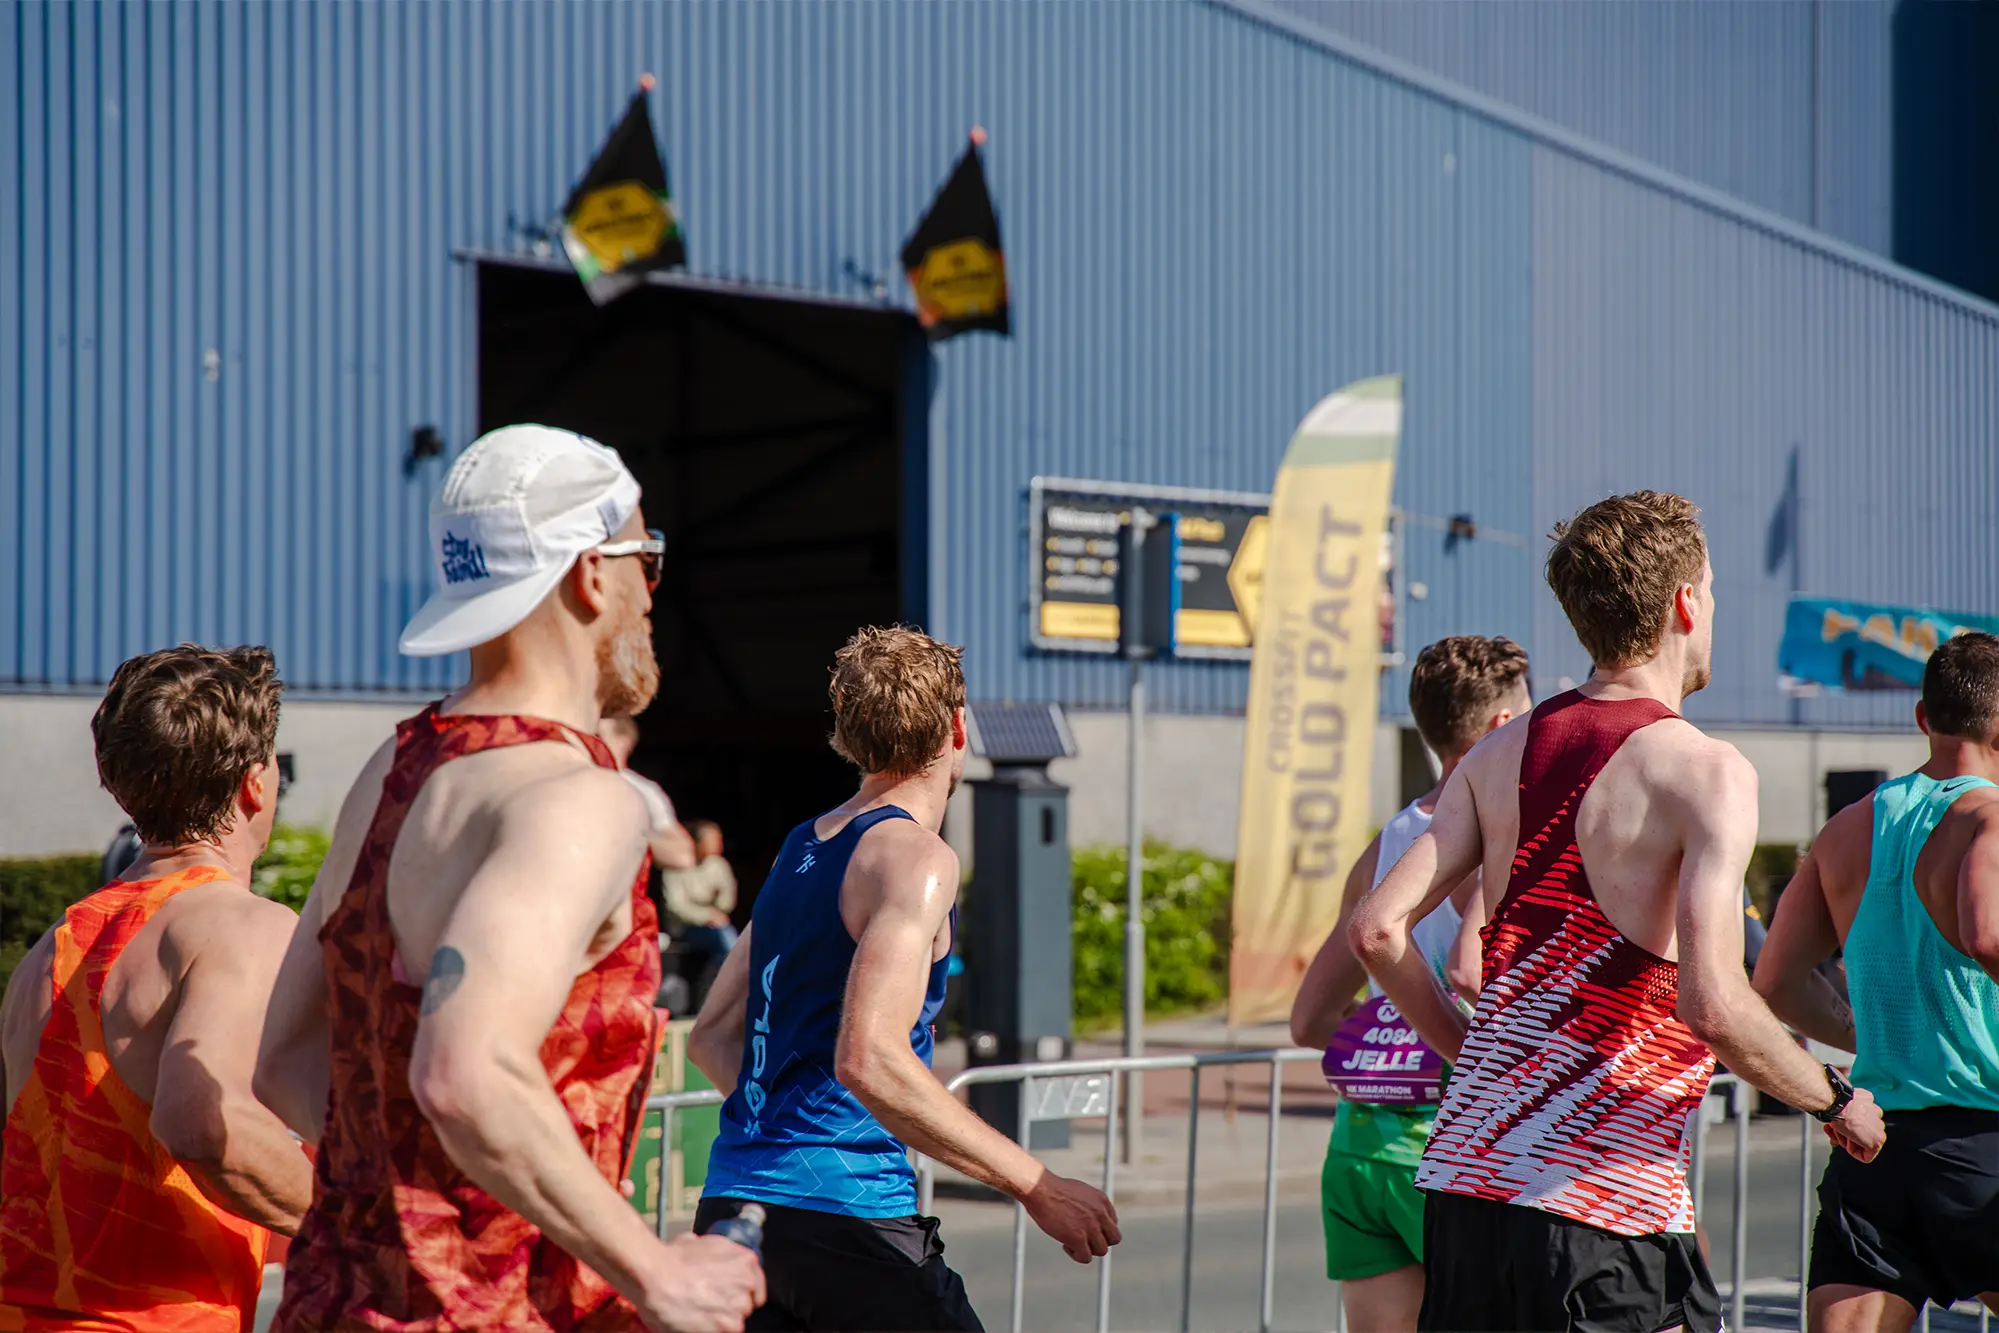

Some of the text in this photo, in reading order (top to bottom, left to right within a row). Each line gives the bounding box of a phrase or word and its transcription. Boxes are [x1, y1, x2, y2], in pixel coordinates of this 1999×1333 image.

[1267, 607, 1304, 775] CROSSFIT
[1289, 504, 1363, 882] GOLD PACT
[1362, 1027, 1418, 1046] 4084
[1341, 1050, 1425, 1071] JELLE
[1357, 1085, 1412, 1095] MARATHON
